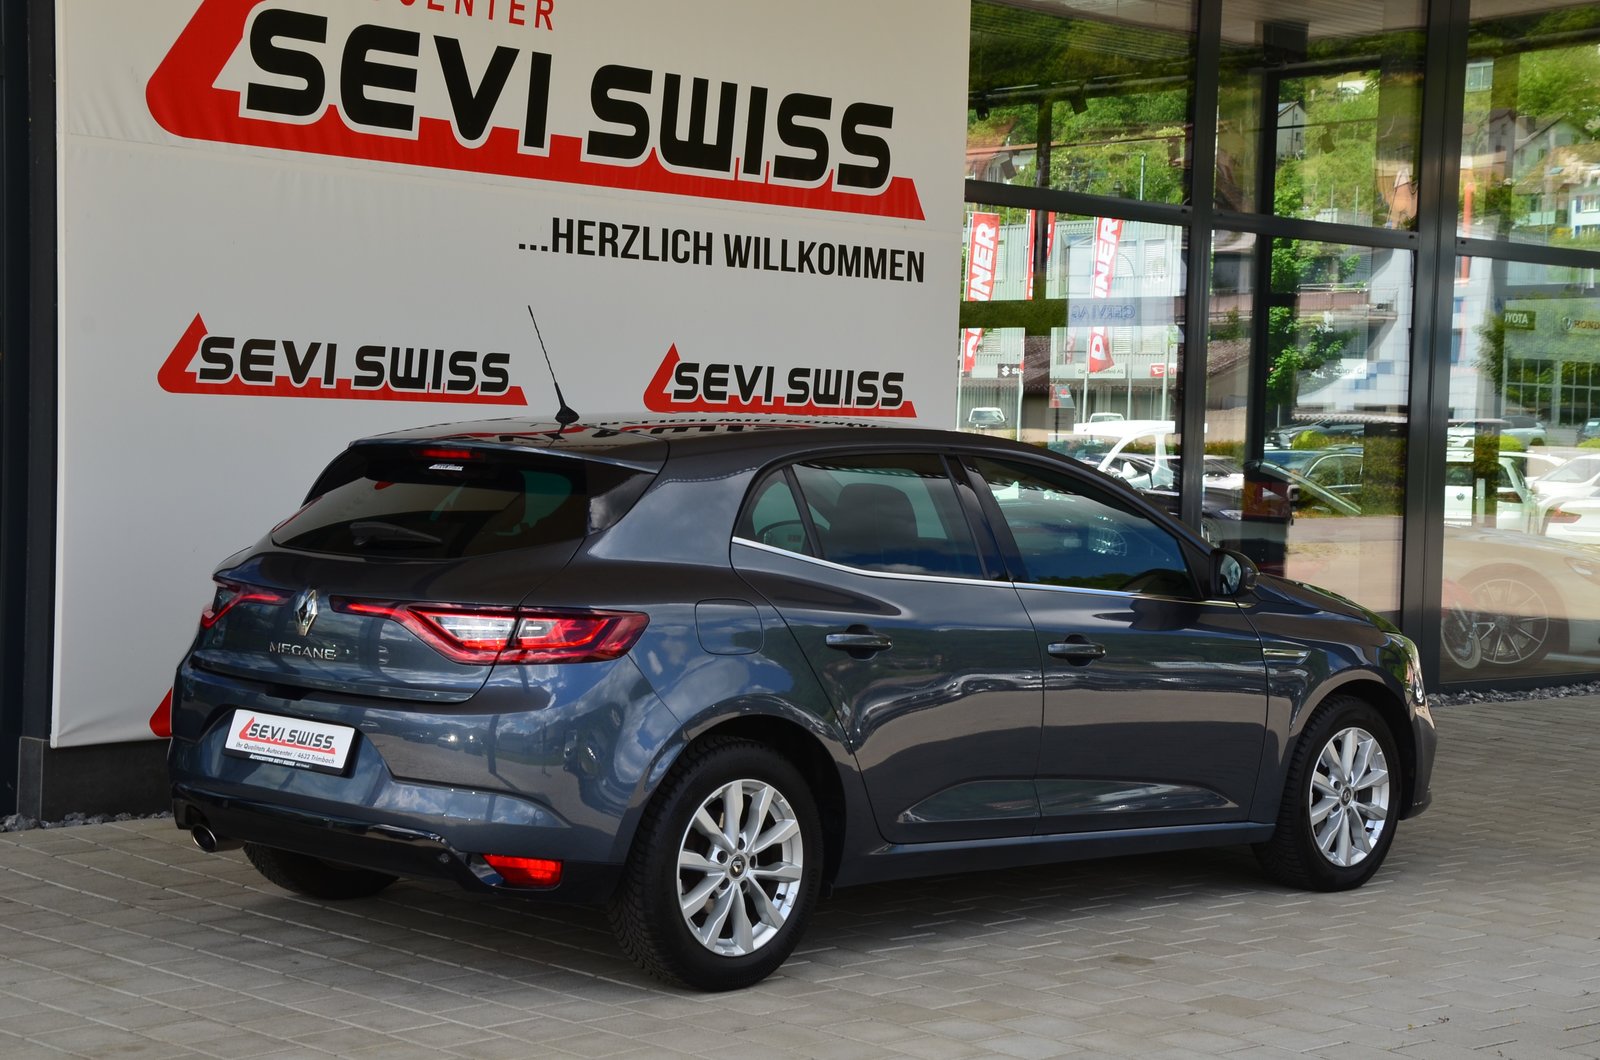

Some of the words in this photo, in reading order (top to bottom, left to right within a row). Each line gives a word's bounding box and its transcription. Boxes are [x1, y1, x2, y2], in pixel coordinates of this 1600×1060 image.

[246, 8, 553, 149] SEVI
[585, 64, 894, 189] SWISS
[723, 233, 925, 283] WILLKOMMEN
[199, 336, 338, 386] SEVI
[353, 345, 511, 393] SWISS
[673, 362, 775, 403] SEVI
[786, 367, 904, 407] SWISS
[249, 723, 285, 741] SEVI
[287, 729, 334, 749] SWISS
